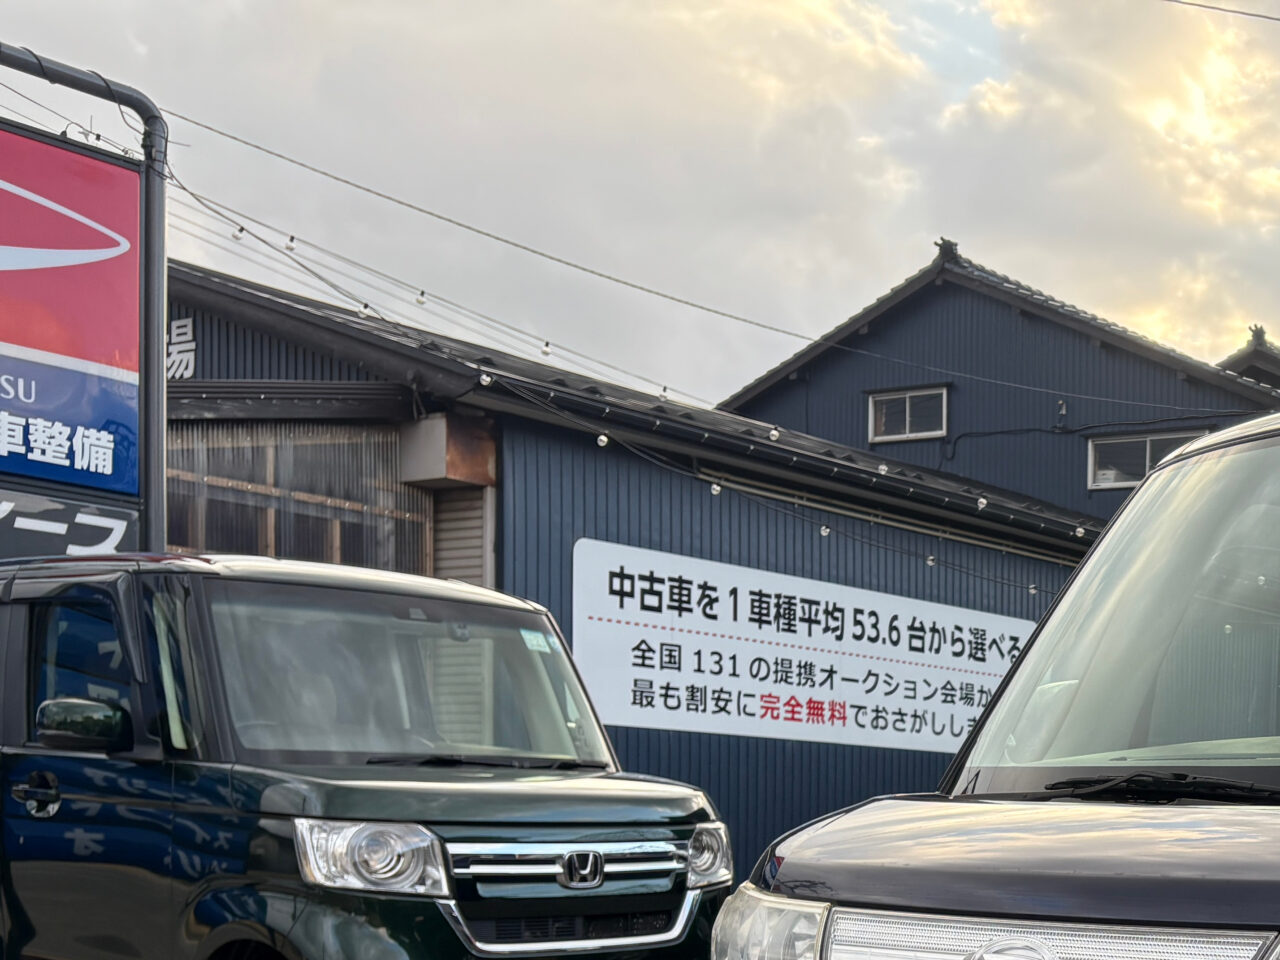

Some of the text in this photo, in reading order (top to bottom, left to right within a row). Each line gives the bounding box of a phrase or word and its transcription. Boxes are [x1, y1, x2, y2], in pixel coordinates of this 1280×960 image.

[0, 374, 36, 404] SU
[0, 411, 115, 475] 車整備
[0, 502, 128, 556] ース
